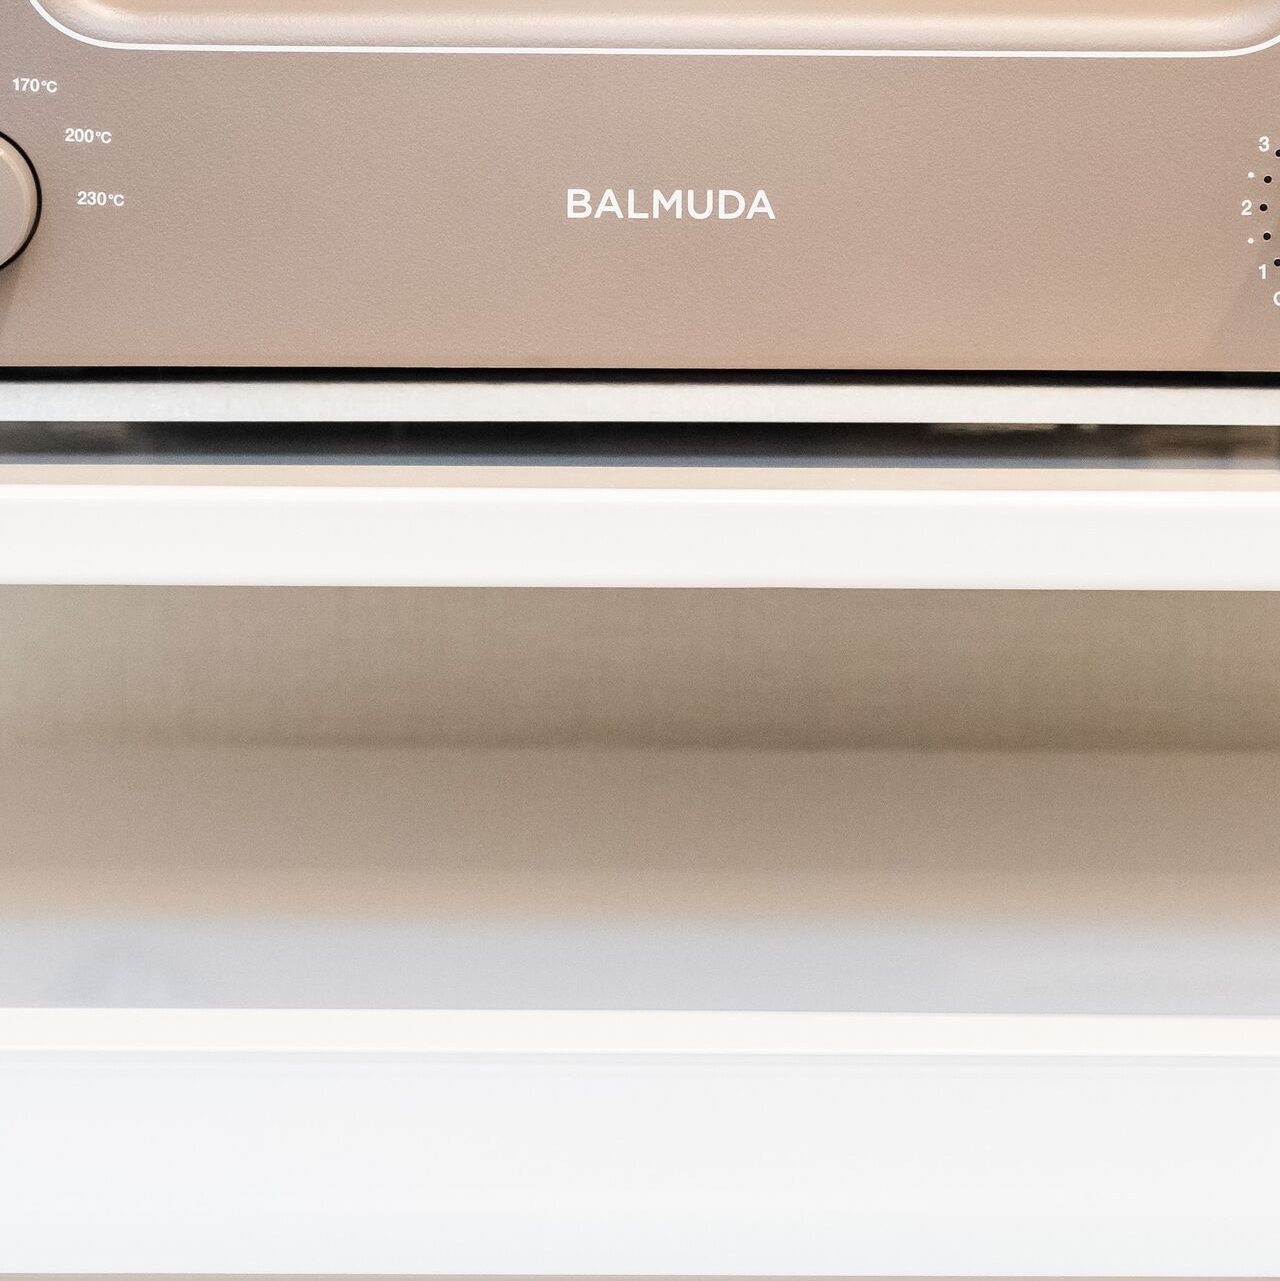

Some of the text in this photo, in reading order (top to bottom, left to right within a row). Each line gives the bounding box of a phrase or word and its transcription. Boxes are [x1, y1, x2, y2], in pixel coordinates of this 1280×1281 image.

[1258, 135, 1270, 153] 3
[566, 188, 776, 220] BALMUDA
[1240, 199, 1253, 216] 2
[1258, 263, 1267, 280] 1
